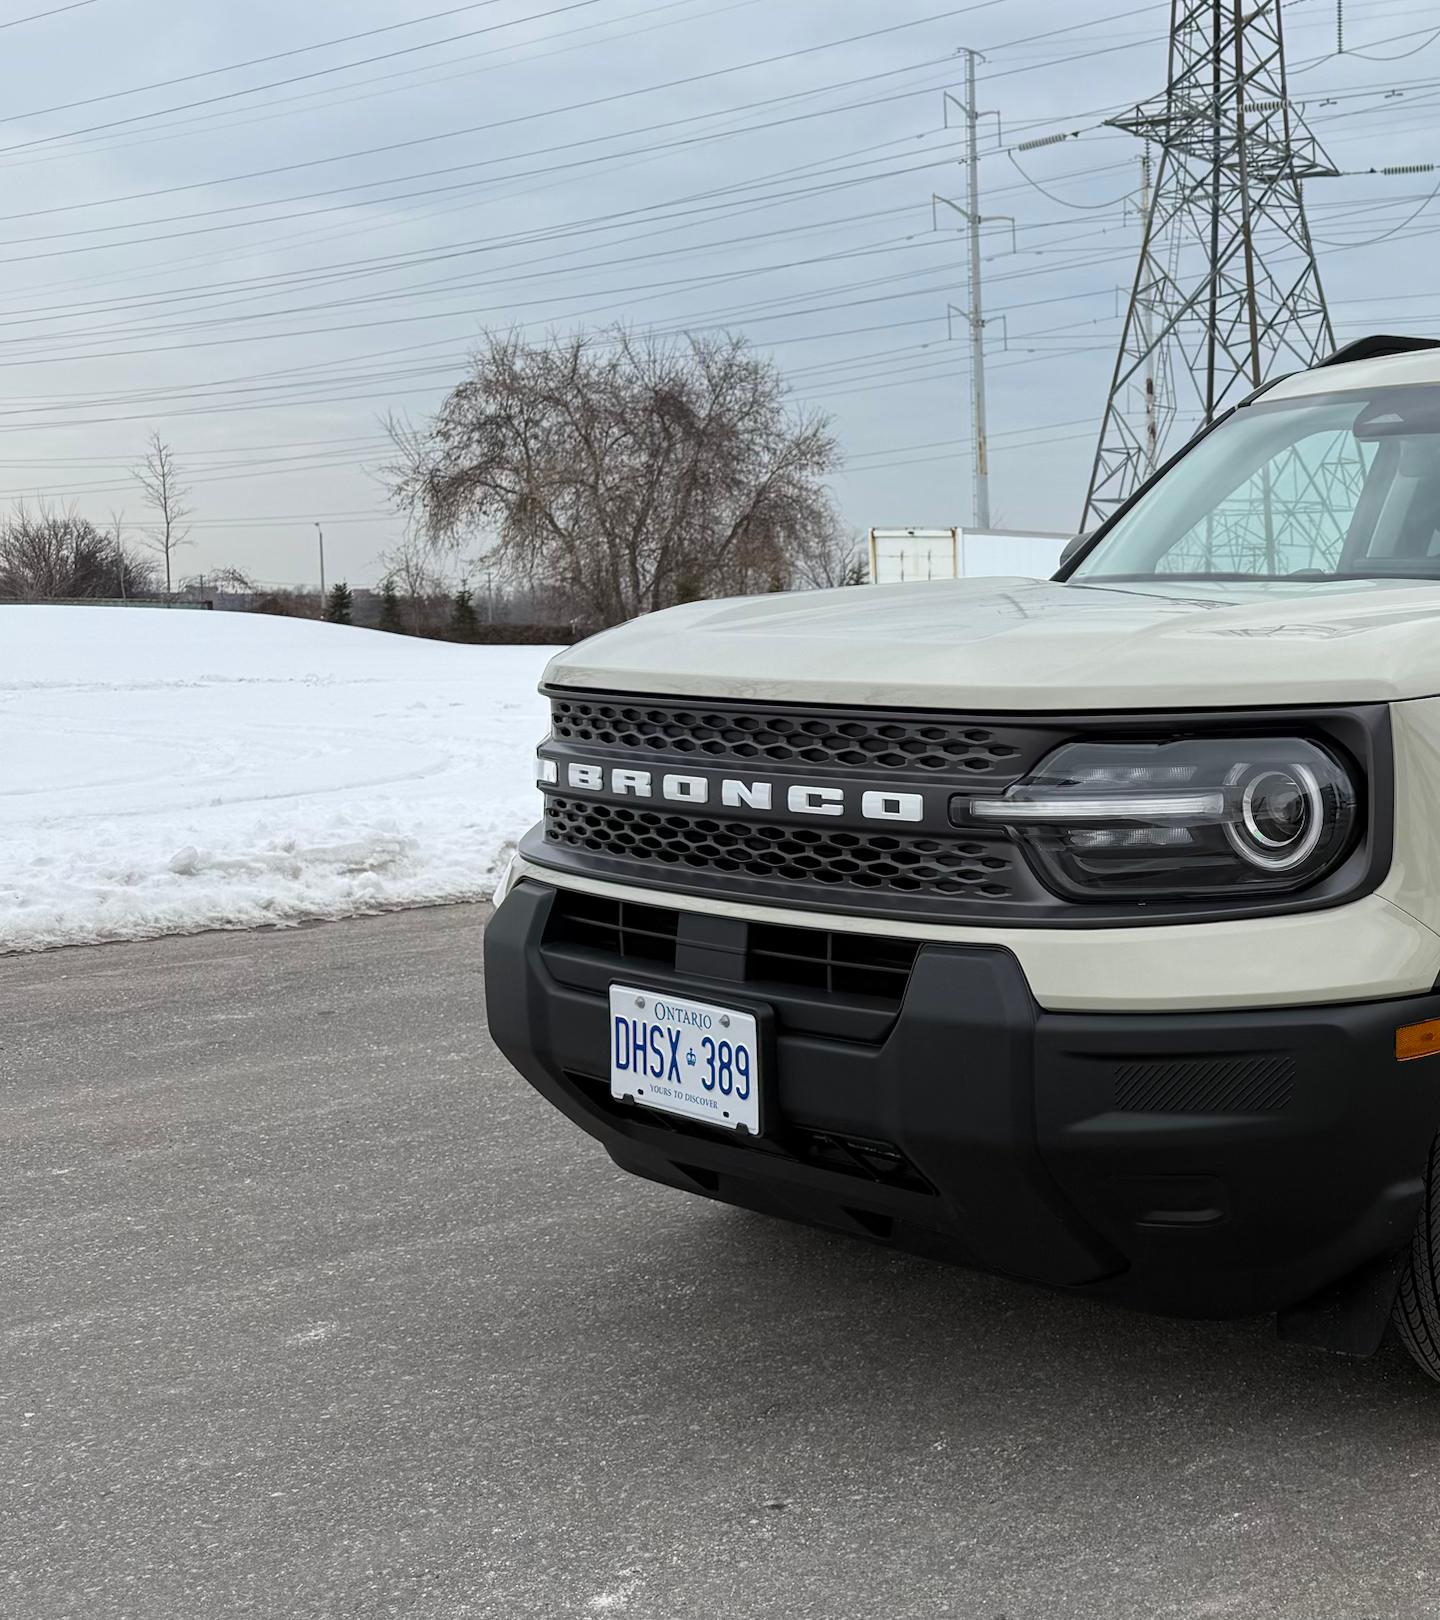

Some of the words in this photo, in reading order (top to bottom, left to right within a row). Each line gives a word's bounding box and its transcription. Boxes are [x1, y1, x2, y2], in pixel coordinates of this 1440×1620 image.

[568, 762, 924, 822] BRONCO
[654, 1002, 712, 1030] ONTARIO
[615, 1016, 682, 1084] DHSX
[701, 1036, 750, 1100] 389
[650, 1084, 672, 1096] YOURS
[673, 1090, 683, 1100] TO
[685, 1093, 718, 1109] DISCOVER
